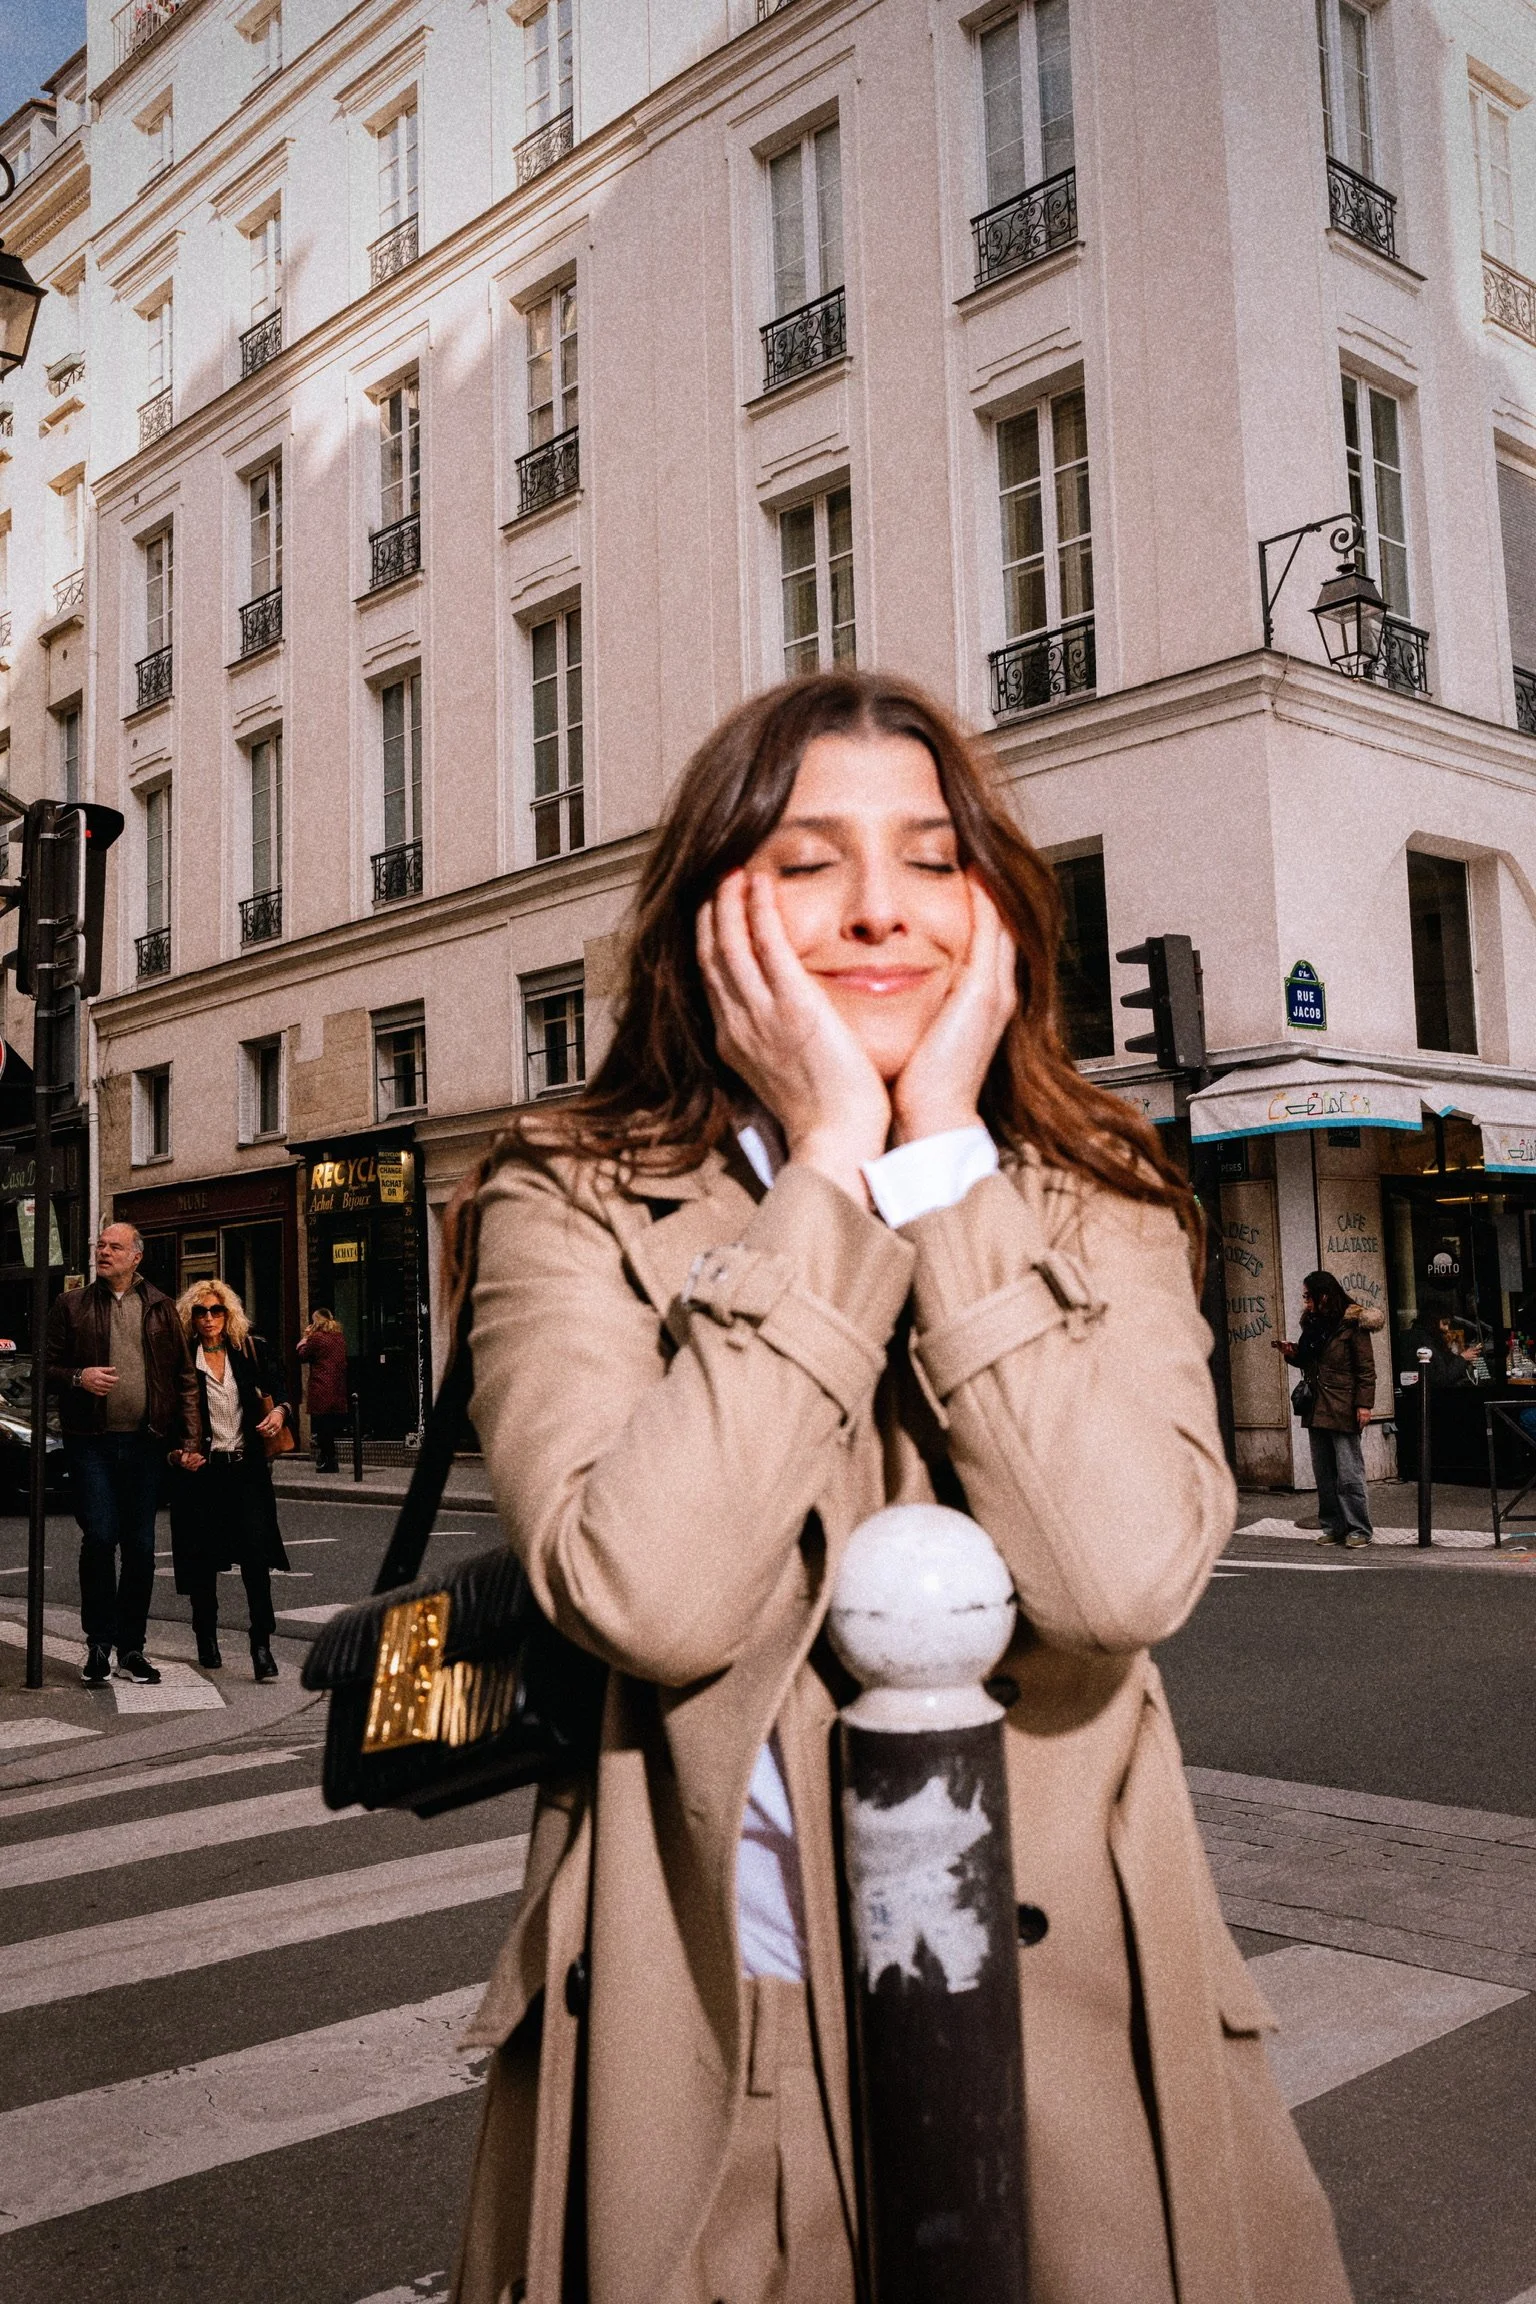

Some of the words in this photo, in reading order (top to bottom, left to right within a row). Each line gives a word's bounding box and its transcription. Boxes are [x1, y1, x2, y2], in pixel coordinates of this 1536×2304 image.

[1297, 990, 1315, 1003] RUE
[1293, 1006, 1321, 1019] JACOB
[311, 1156, 379, 1190] RECYCL
[379, 1166, 402, 1174] CHANGE
[381, 1180, 402, 1188] ACHAT
[387, 1188, 397, 1196] OR
[309, 1193, 334, 1213] Achat
[342, 1191, 371, 1211] Bijoux
[1427, 1263, 1460, 1274] PHOTO
[1340, 1272, 1380, 1299] OCOLAT
